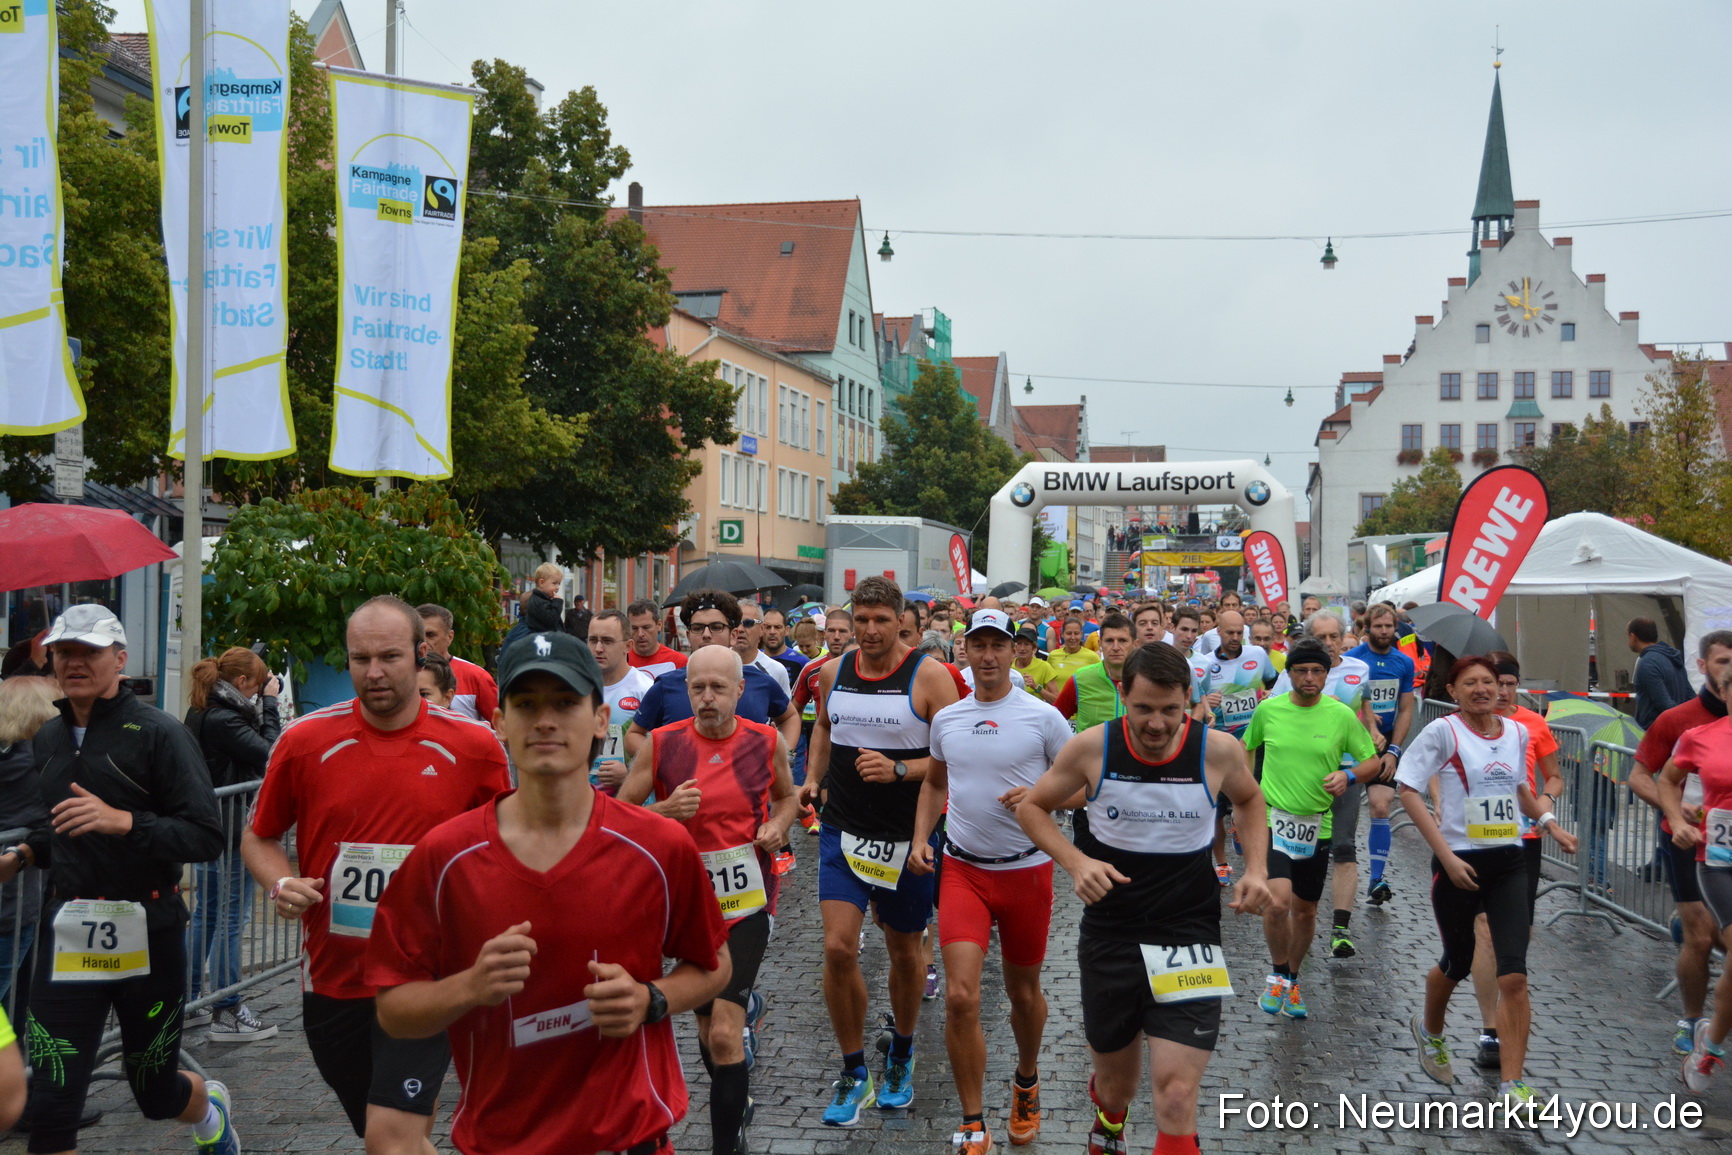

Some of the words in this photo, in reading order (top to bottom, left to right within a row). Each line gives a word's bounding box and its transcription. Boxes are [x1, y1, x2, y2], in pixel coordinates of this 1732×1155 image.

[352, 166, 412, 186] Kampagne
[351, 178, 419, 202] Fairtrade
[380, 203, 412, 219] Towns
[424, 209, 455, 220] FAIRTRADE
[390, 288, 432, 312] sind
[350, 347, 408, 371] Stadt!
[1043, 471, 1111, 492] BMW
[1116, 471, 1236, 495] Laufsport
[723, 523, 740, 541] D
[1181, 554, 1205, 564] ZIEL
[1448, 486, 1534, 615] REWE
[1371, 687, 1396, 701] 919
[1225, 696, 1256, 714] 2120
[840, 714, 867, 723] Autohaus
[868, 716, 875, 724] J.
[884, 717, 901, 725] LELL
[1121, 809, 1156, 818] Autohaus
[1158, 810, 1166, 818] J.
[1479, 799, 1514, 821] 146
[1275, 819, 1317, 842] 2306
[853, 836, 896, 863] 259
[853, 860, 886, 878] Maurice
[342, 866, 399, 903] 20
[94, 903, 136, 914] BOCK
[720, 898, 740, 911] eter
[81, 921, 118, 950] 73
[82, 956, 120, 969] Harald
[1177, 973, 1213, 987] Flocke
[536, 1013, 572, 1033] DEHN
